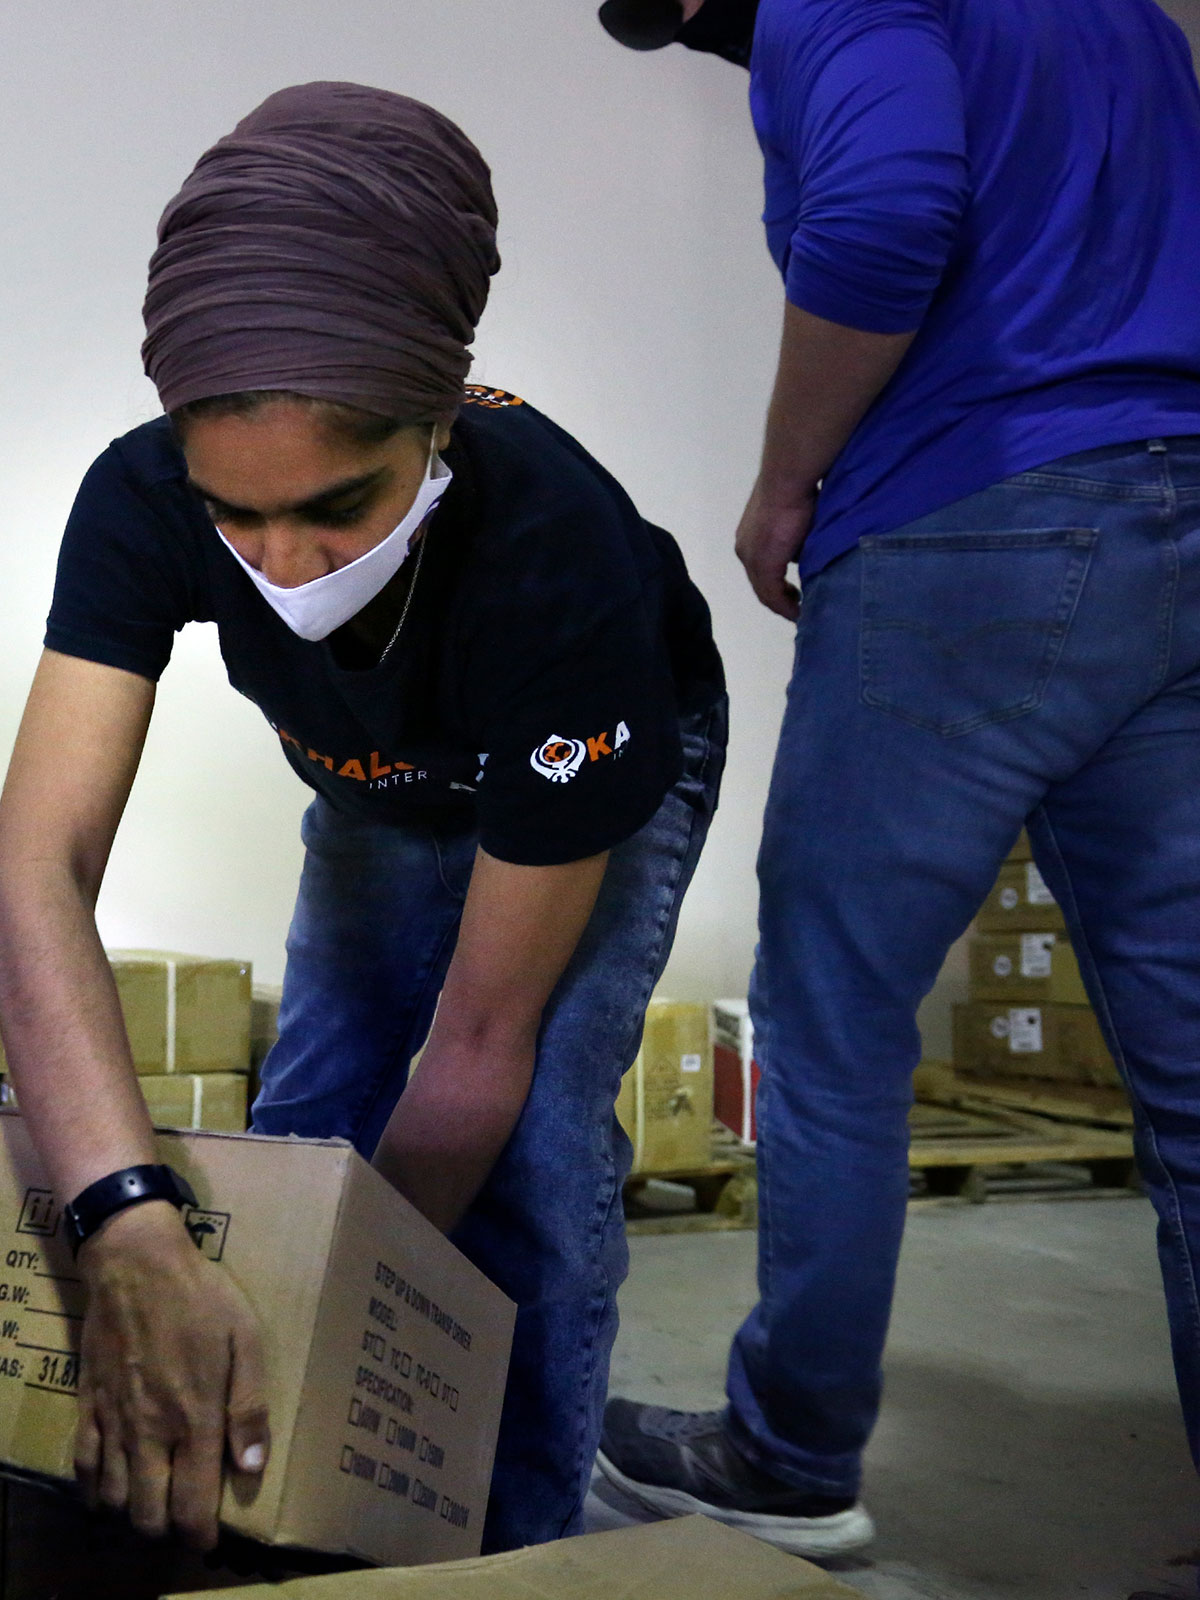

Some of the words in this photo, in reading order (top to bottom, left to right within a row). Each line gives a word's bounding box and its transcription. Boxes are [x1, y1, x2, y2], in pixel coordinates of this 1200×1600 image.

[586, 720, 631, 762] KA
[6, 1250, 39, 1270] QTY:
[375, 1261, 396, 1289] STEP
